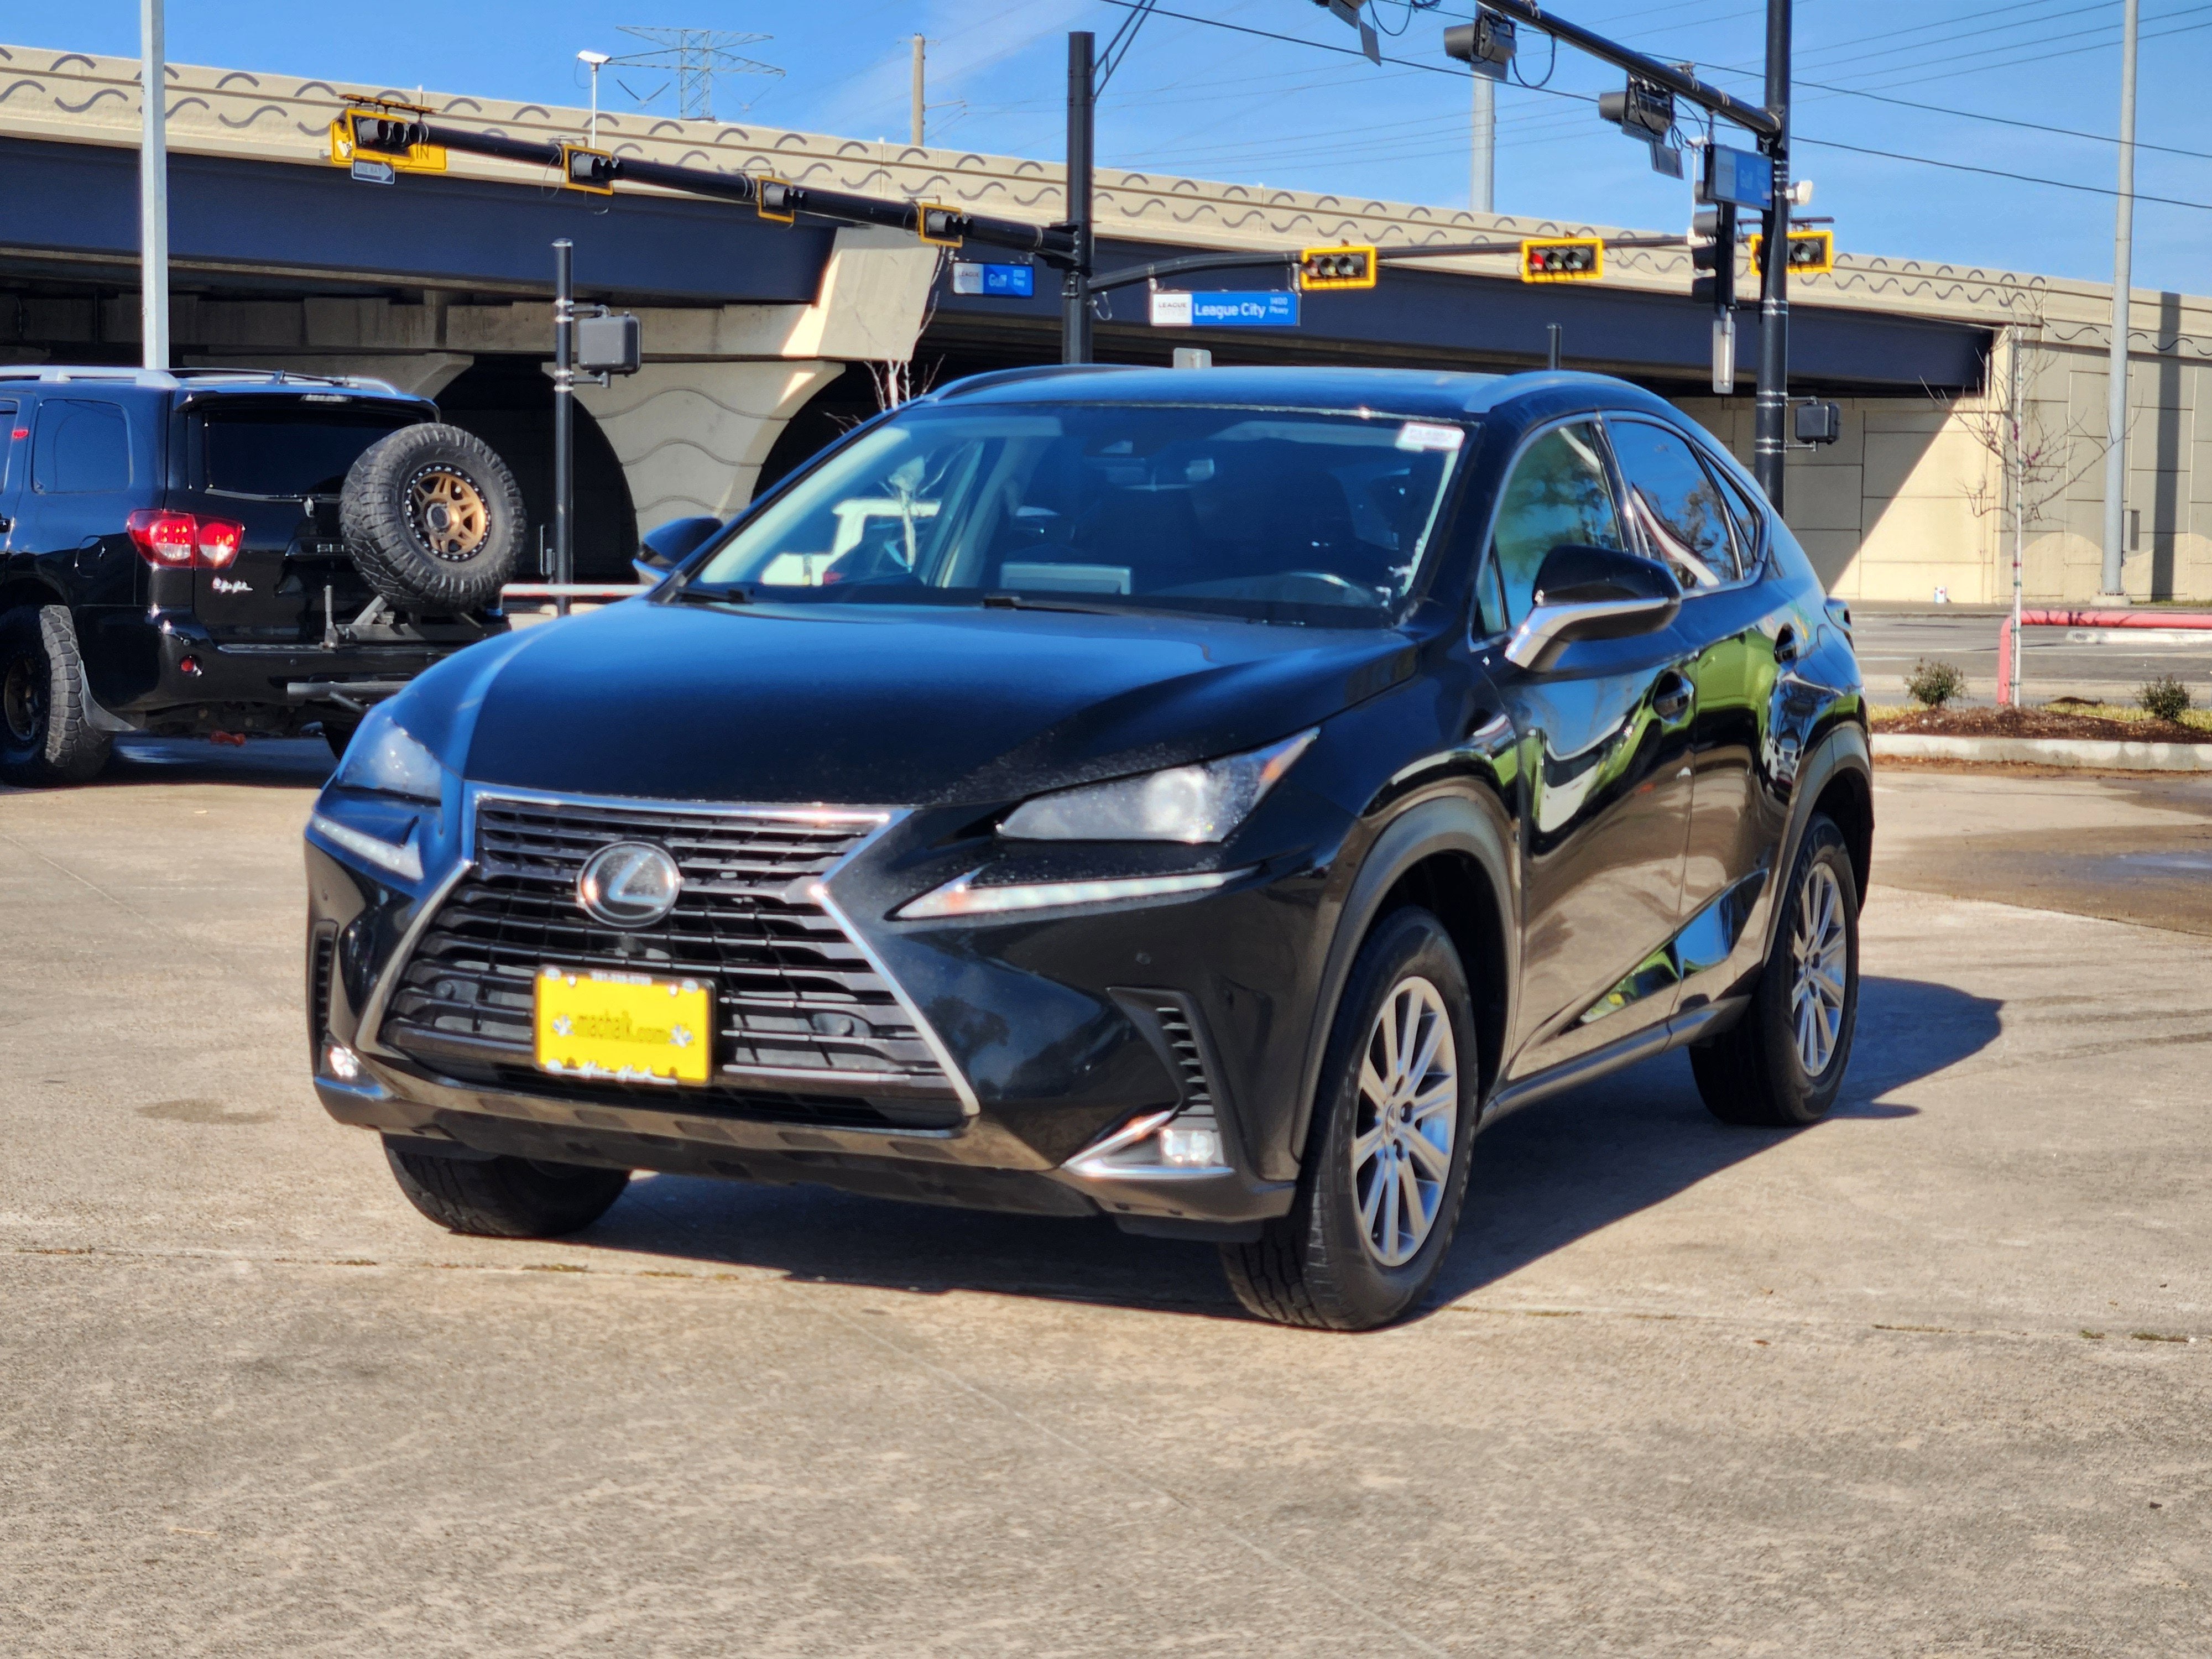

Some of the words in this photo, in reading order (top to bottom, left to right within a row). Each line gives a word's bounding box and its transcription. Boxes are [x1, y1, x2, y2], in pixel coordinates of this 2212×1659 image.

[356, 163, 368, 173] ONE
[370, 165, 381, 175] WAY
[1194, 303, 1238, 320] League
[1240, 302, 1266, 319] City
